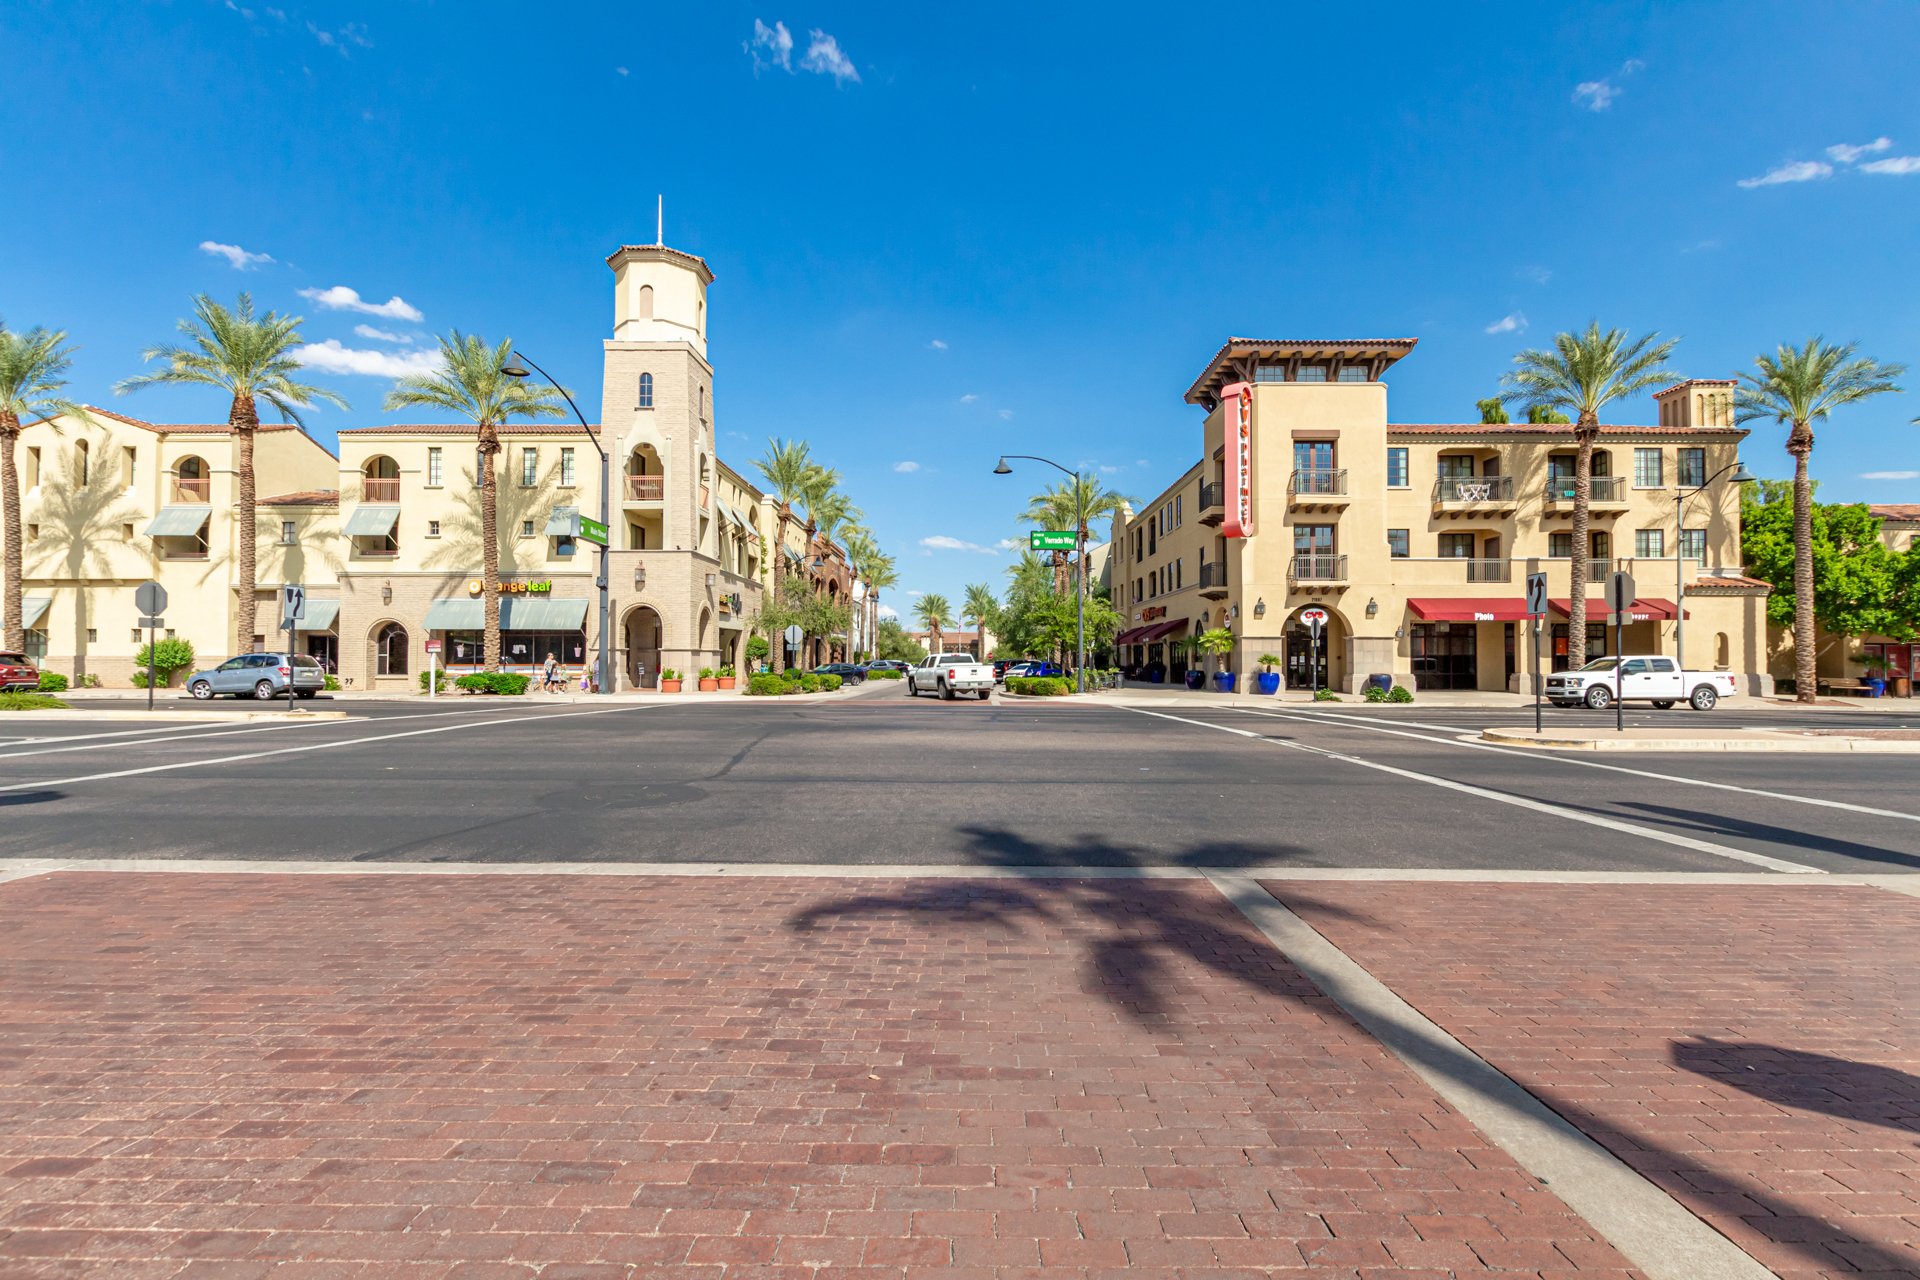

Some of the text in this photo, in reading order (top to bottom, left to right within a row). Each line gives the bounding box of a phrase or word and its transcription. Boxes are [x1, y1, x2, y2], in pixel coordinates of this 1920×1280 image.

[1063, 537, 1075, 546] Way
[483, 580, 551, 593] ange leaf
[1305, 611, 1324, 619] CVS
[1474, 612, 1495, 621] Photo
